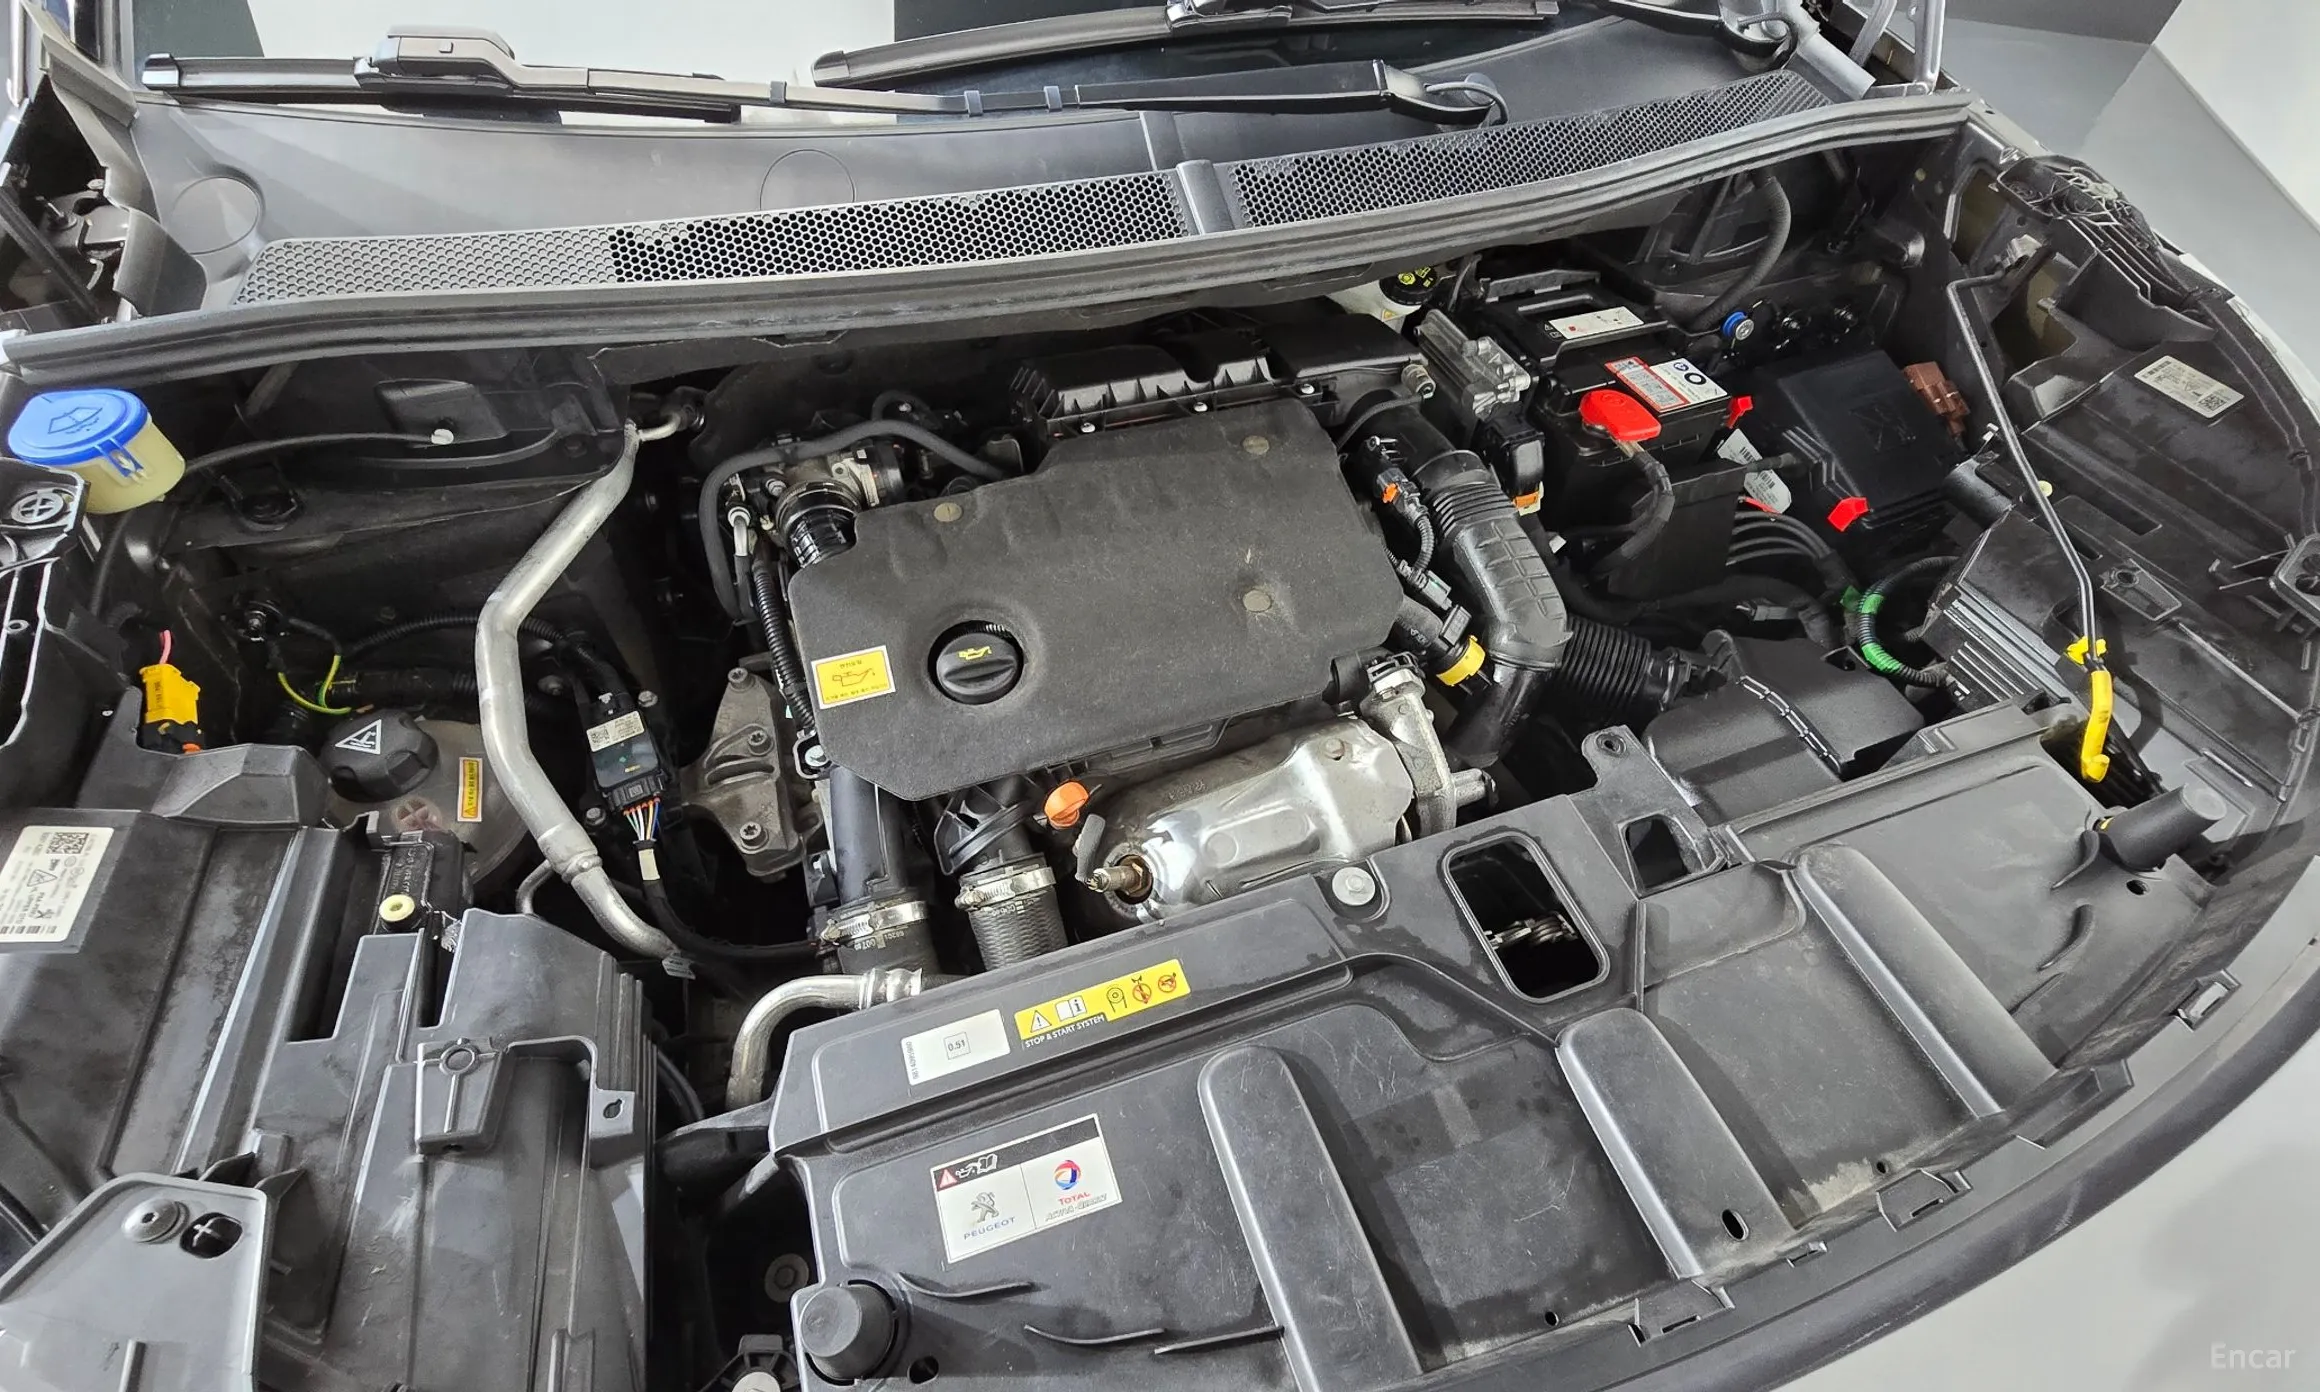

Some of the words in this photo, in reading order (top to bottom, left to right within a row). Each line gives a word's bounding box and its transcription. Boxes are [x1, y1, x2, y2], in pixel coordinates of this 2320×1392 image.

[1025, 1036, 1045, 1048] STOP
[1051, 1025, 1076, 1038] START
[1076, 1014, 1105, 1030] SYSTEM
[948, 1039, 967, 1052] 0.51
[1058, 1192, 1091, 1206] TOTAL
[963, 1217, 1016, 1240] PEUGEOT
